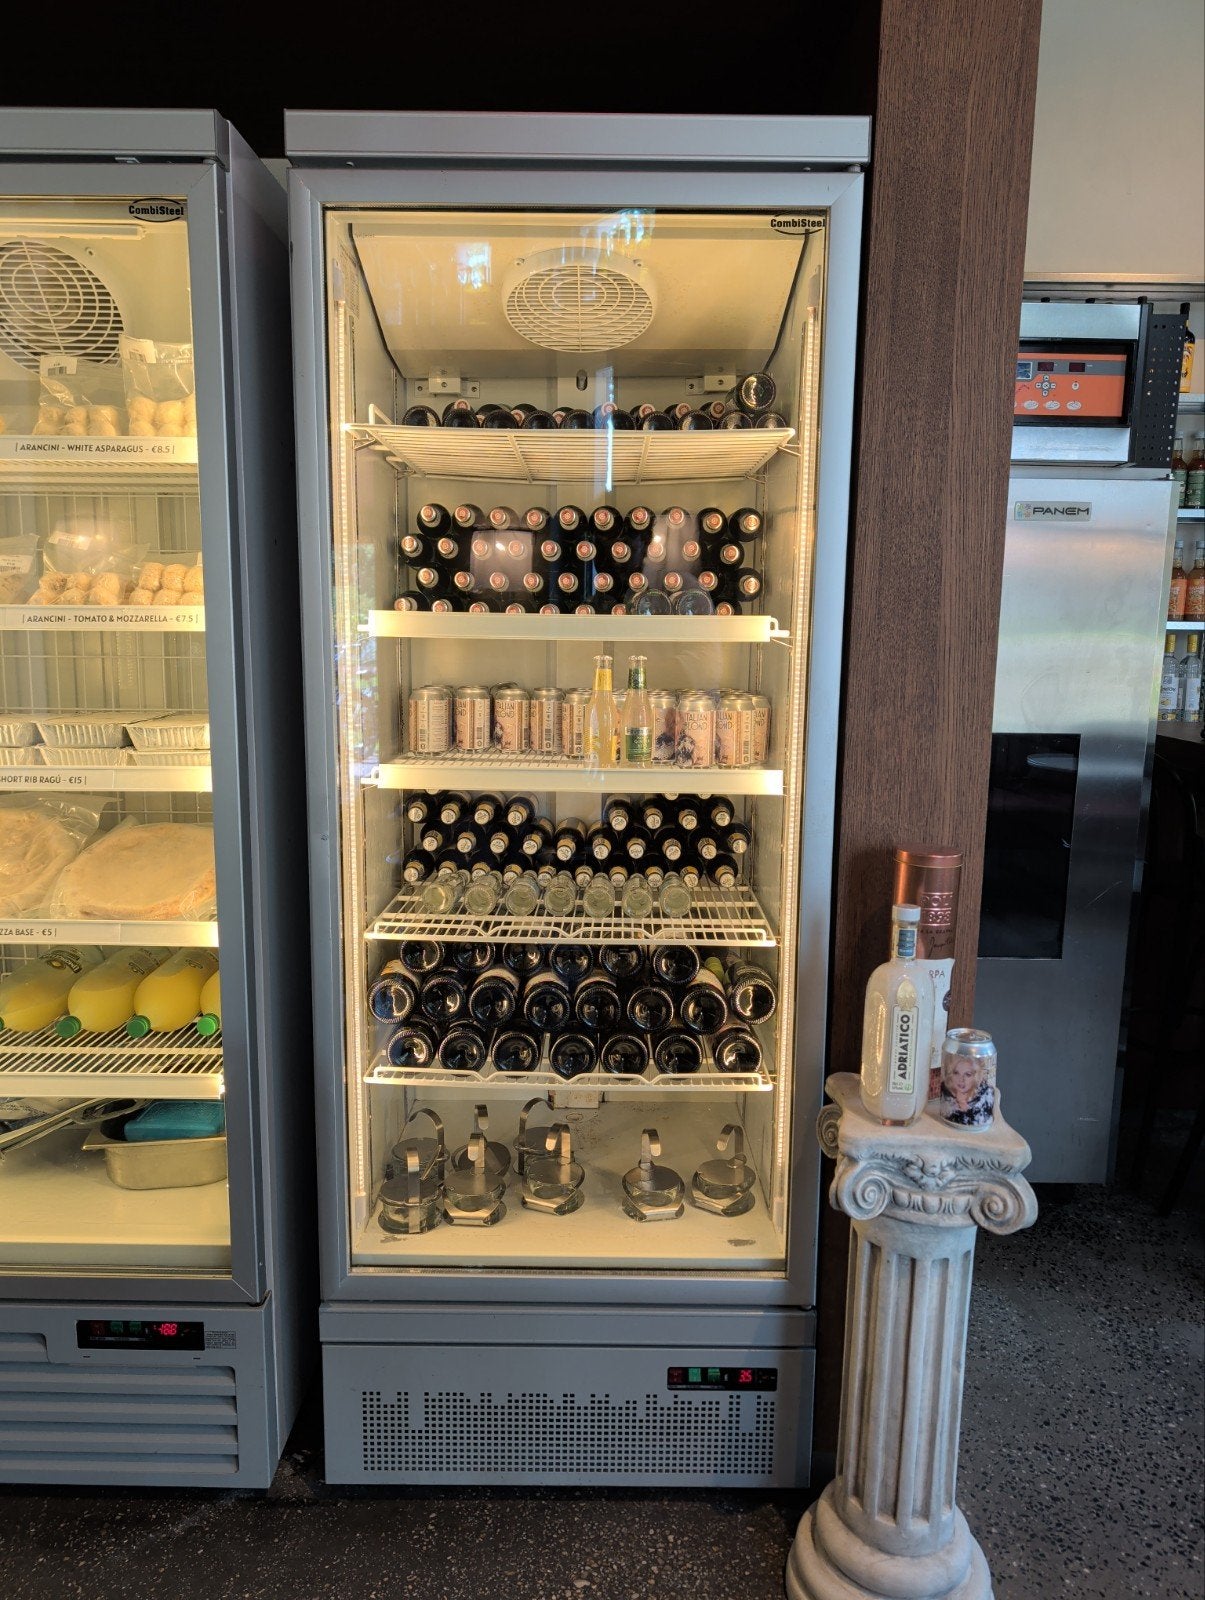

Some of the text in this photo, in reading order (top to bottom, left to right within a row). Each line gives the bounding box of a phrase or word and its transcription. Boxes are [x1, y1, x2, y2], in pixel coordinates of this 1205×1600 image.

[128, 205, 185, 216] CombiSteel
[770, 218, 826, 228] CombiSteel
[67, 444, 93, 452] WHITE
[95, 445, 143, 453] ASPARAGUS
[1033, 507, 1089, 515] PANEM
[27, 615, 66, 623] ARANCINI
[74, 615, 107, 623] TOMATO
[898, 1014, 910, 1080] ADRIATICO
